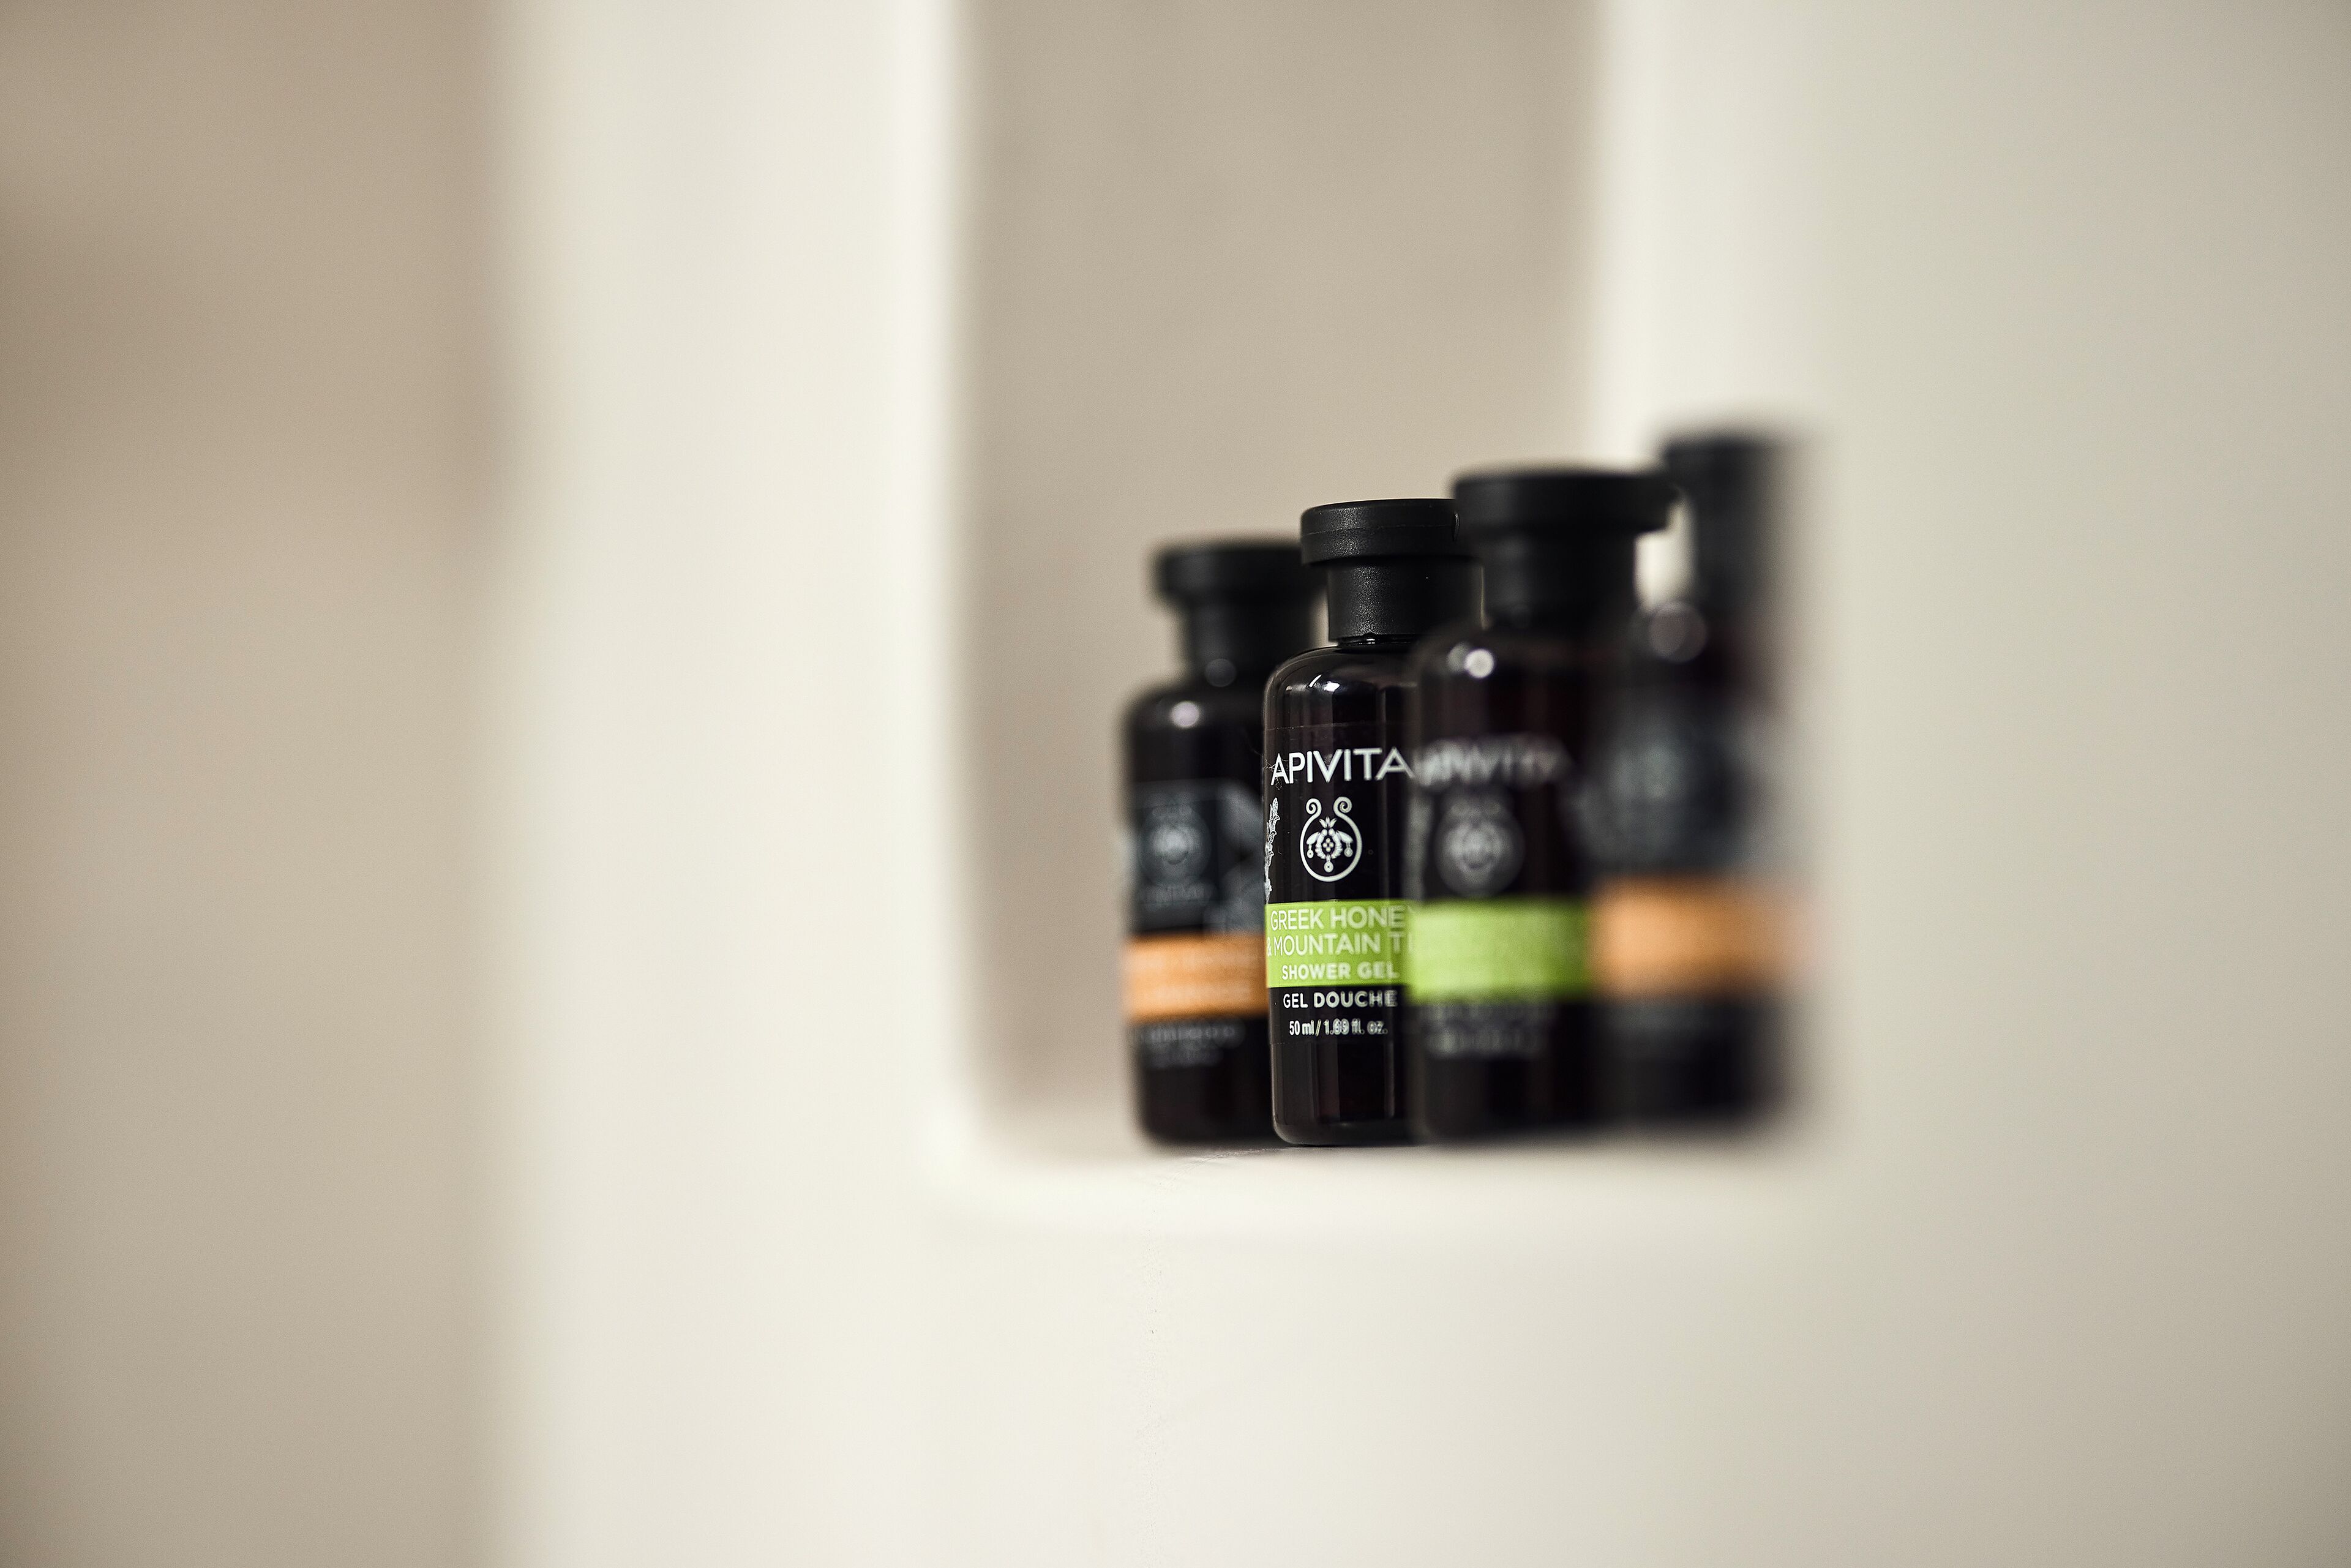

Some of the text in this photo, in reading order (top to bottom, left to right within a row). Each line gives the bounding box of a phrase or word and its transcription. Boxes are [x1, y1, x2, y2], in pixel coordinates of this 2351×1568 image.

[1270, 746, 1414, 786] APIVITA
[1270, 904, 1412, 931] GREEK HONE
[1267, 936, 1272, 958] &
[1273, 932, 1381, 956] MOUNTAIN
[1281, 960, 1401, 980] SHOWER GEL
[1283, 990, 1398, 1008] GEL DOUCHE
[1289, 1020, 1300, 1035] 50
